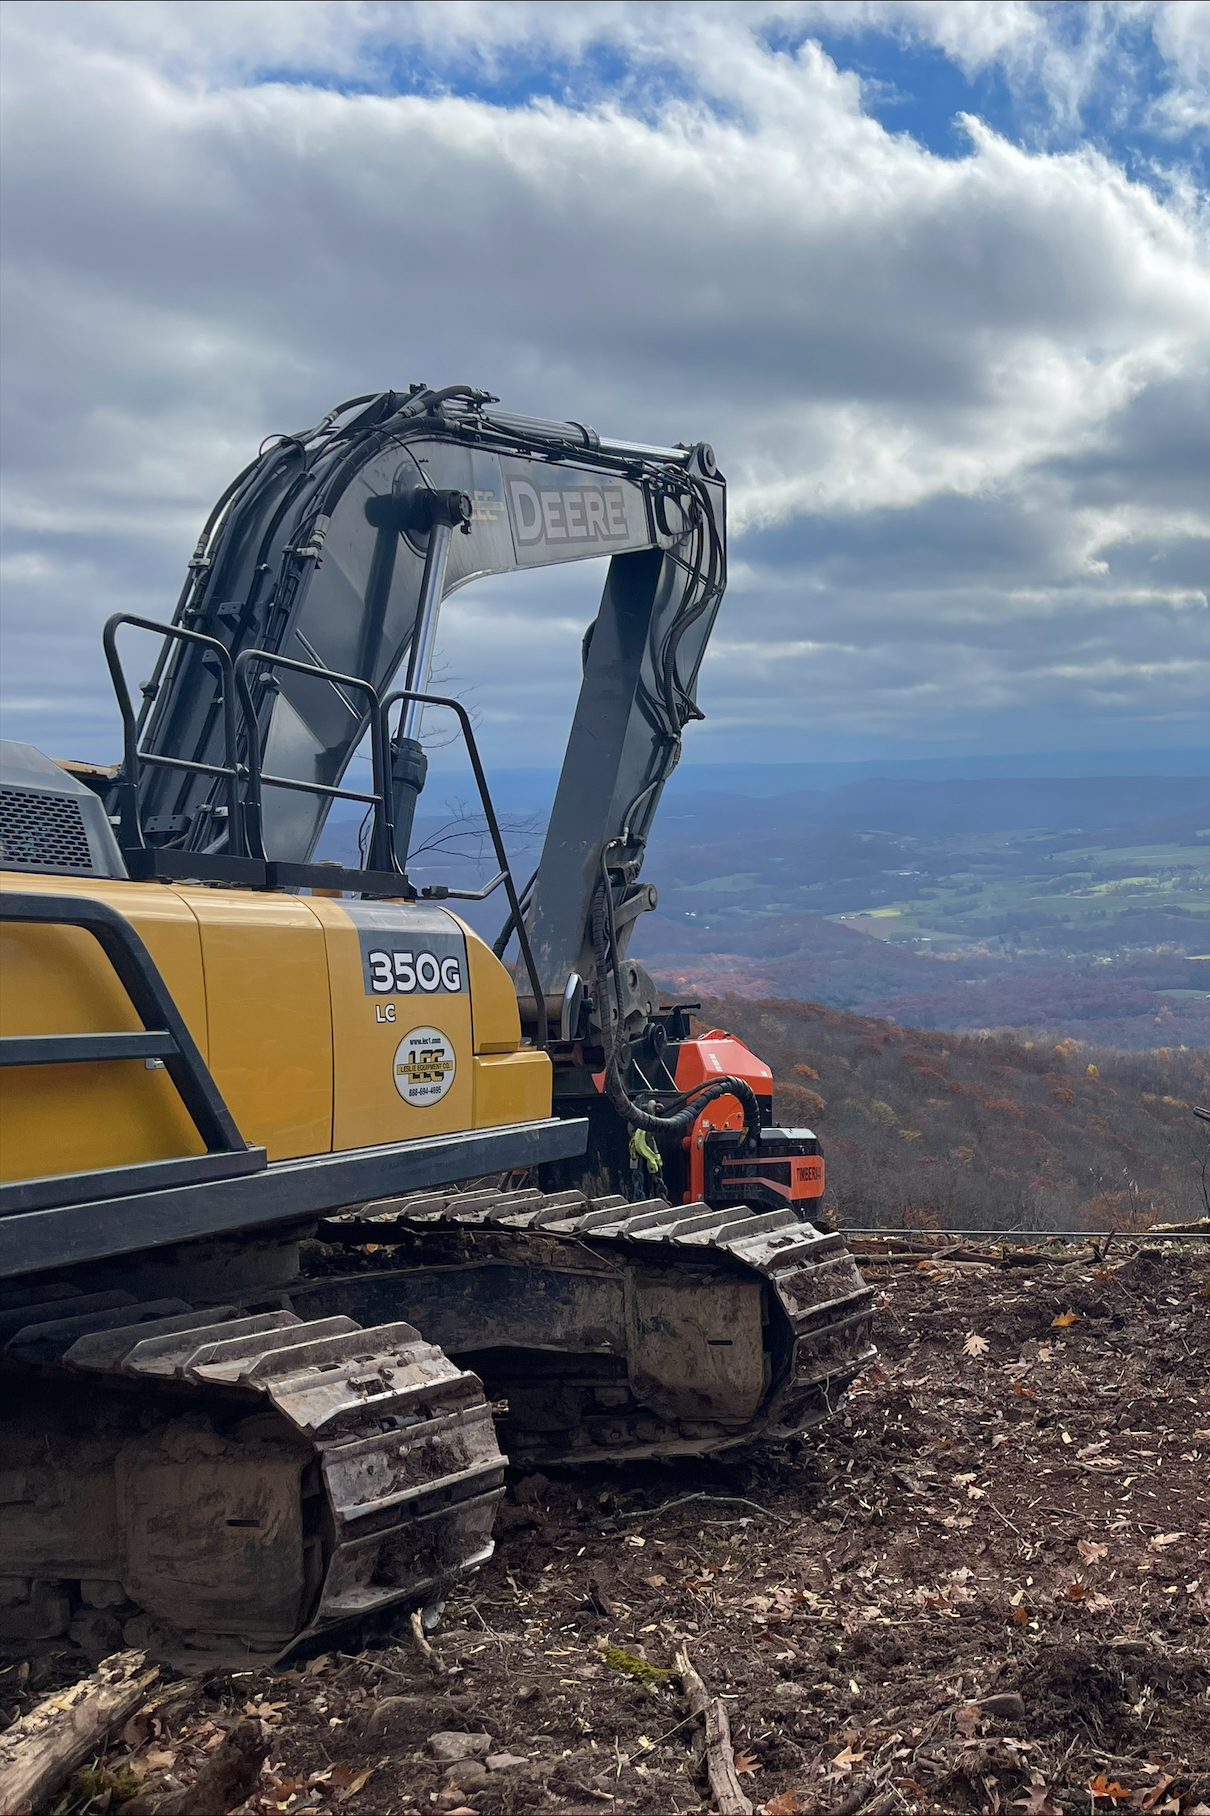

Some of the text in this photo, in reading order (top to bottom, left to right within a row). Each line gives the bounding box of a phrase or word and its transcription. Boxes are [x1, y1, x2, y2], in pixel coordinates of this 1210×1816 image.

[507, 477, 629, 543] DEERE
[368, 949, 462, 993] 350G
[375, 1003, 396, 1023] LC
[400, 1064, 417, 1073] LESLIE
[417, 1062, 442, 1072] EQUIPMENT
[408, 1049, 444, 1084] LEC
